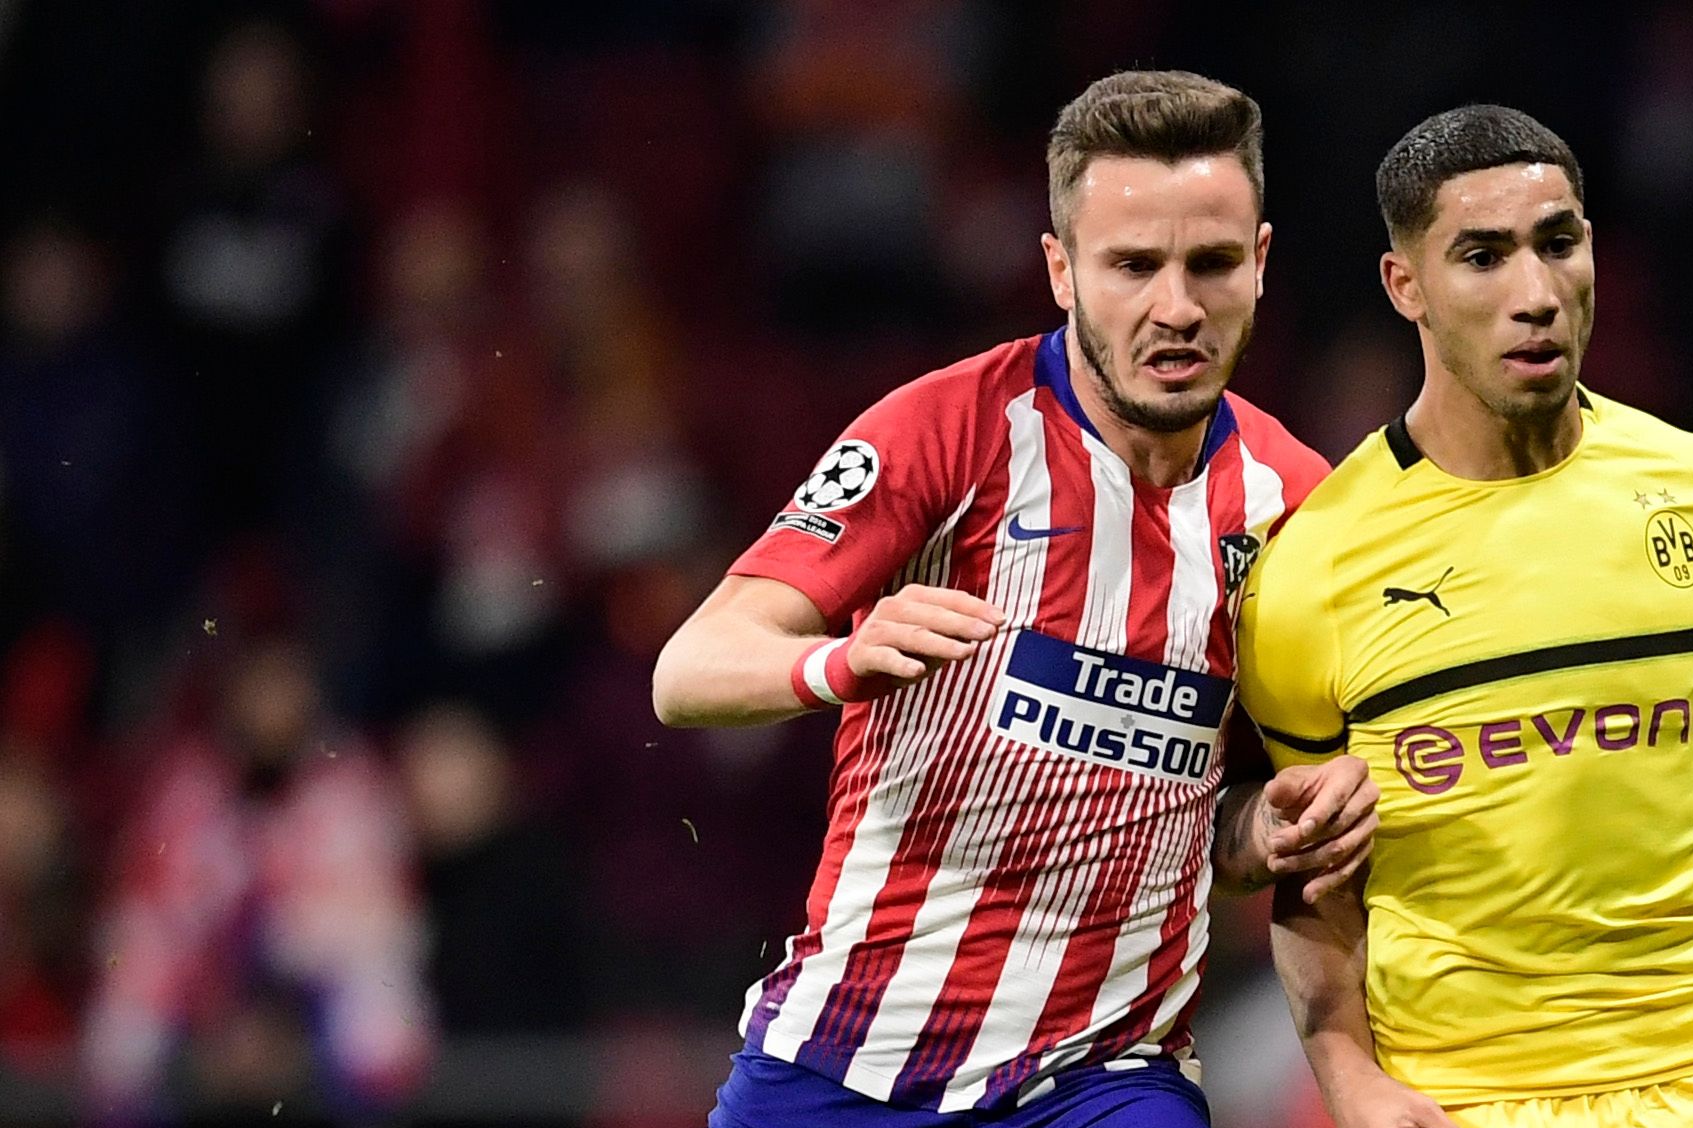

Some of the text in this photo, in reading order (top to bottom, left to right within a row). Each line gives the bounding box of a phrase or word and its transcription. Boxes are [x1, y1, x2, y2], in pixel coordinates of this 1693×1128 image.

[1673, 564, 1690, 582] 09
[1072, 651, 1199, 718] Trade
[996, 690, 1212, 779] Plus500
